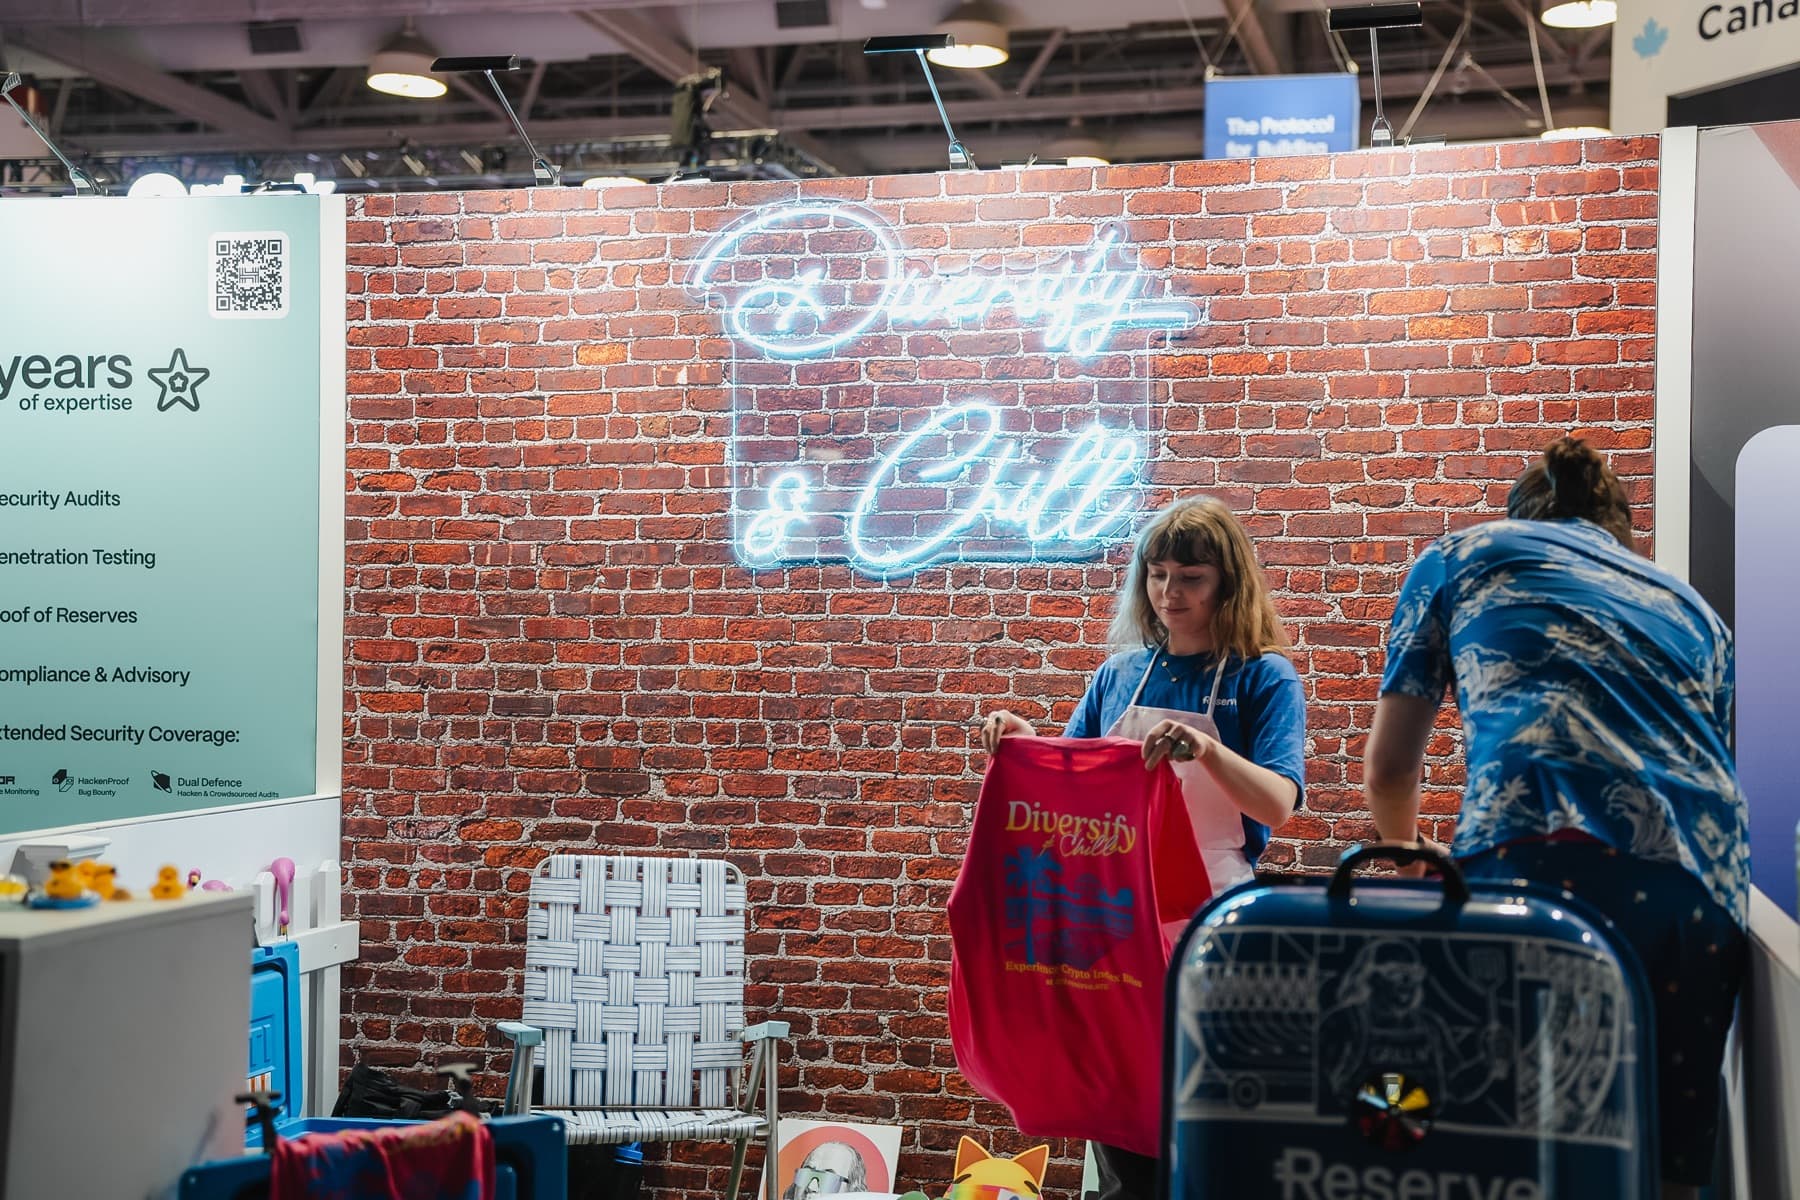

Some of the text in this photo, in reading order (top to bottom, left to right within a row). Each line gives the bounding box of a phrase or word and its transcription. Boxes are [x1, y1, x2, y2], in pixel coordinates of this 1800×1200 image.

[1226, 114, 1335, 136] The Protocol
[0, 354, 133, 400] years
[19, 393, 133, 415] of expertise
[851, 402, 1139, 565] Chill
[64, 490, 121, 507] Audits
[92, 549, 156, 569] Testing
[33, 606, 53, 623] of
[56, 607, 138, 624] Reserves
[94, 667, 108, 683] &
[111, 666, 191, 687] Advisory
[70, 725, 145, 746] Security
[149, 725, 241, 747] Coverage:
[77, 777, 130, 786] HackenProof
[177, 777, 242, 788] Dual Defence
[4, 788, 40, 797] Monitoring
[78, 788, 117, 798] Bug Bounty
[177, 790, 281, 799] Hacken & Crowdsourced Audits
[1005, 800, 1137, 855] Diversify
[1059, 832, 1121, 858] Chill
[1061, 963, 1091, 979] Crypto
